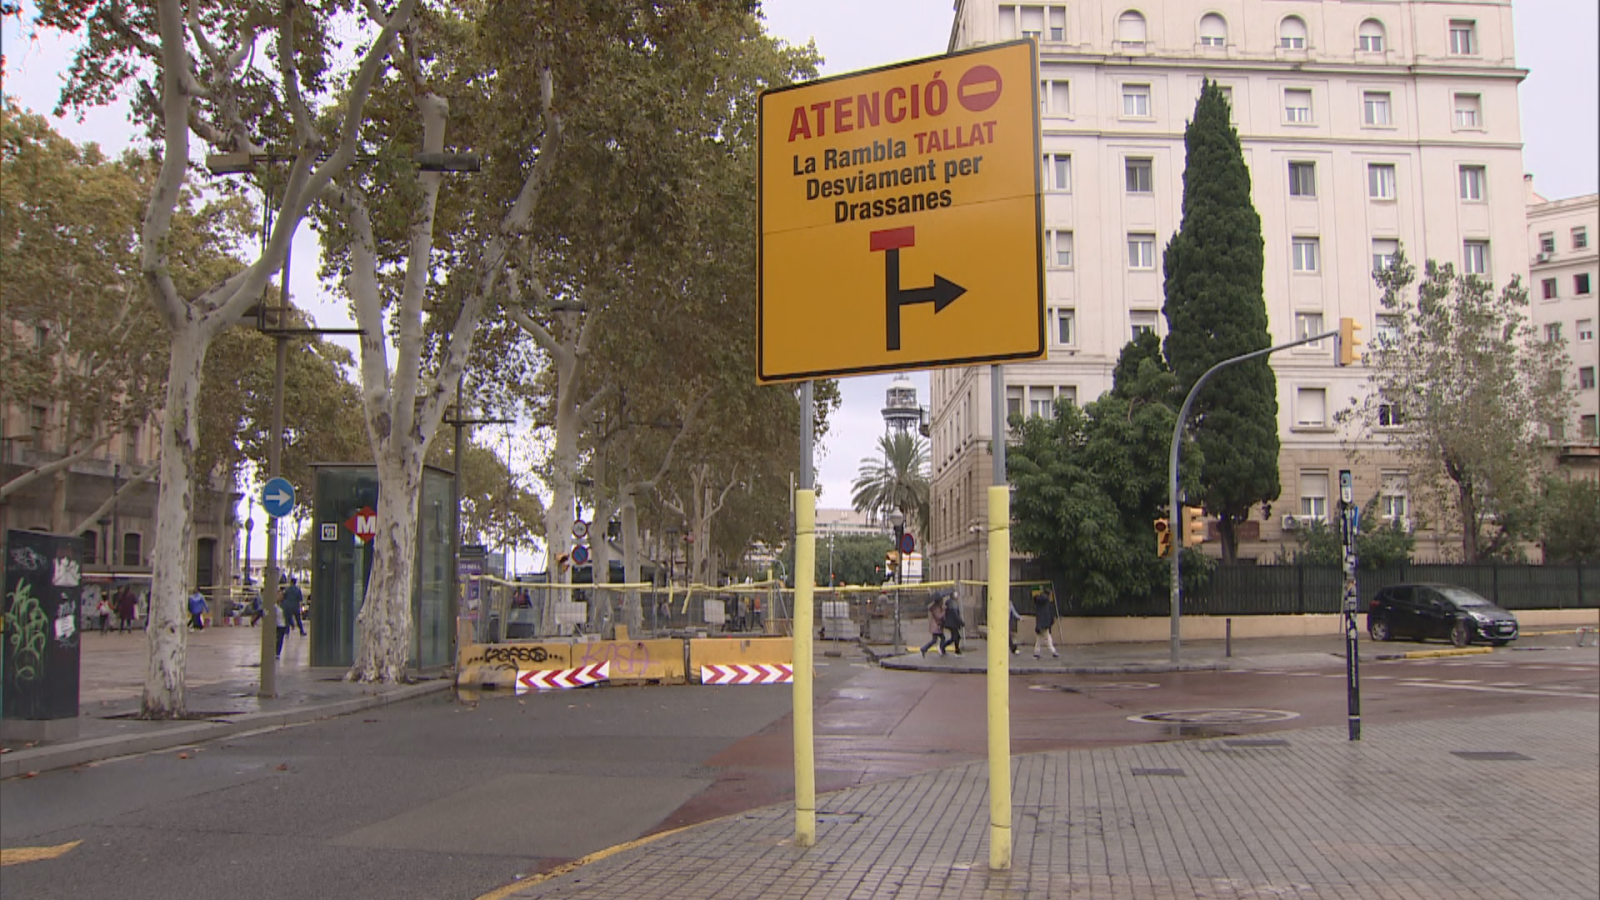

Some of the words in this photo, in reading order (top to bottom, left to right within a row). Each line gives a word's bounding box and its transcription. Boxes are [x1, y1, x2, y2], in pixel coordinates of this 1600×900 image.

[787, 70, 949, 142] ATENCIÓ
[793, 154, 816, 176] La
[824, 138, 907, 170] Rambla
[914, 120, 998, 155] TALLAT
[806, 158, 937, 201] Desviament
[944, 154, 983, 184] per
[834, 188, 952, 223] Drassanes
[356, 515, 376, 534] M
